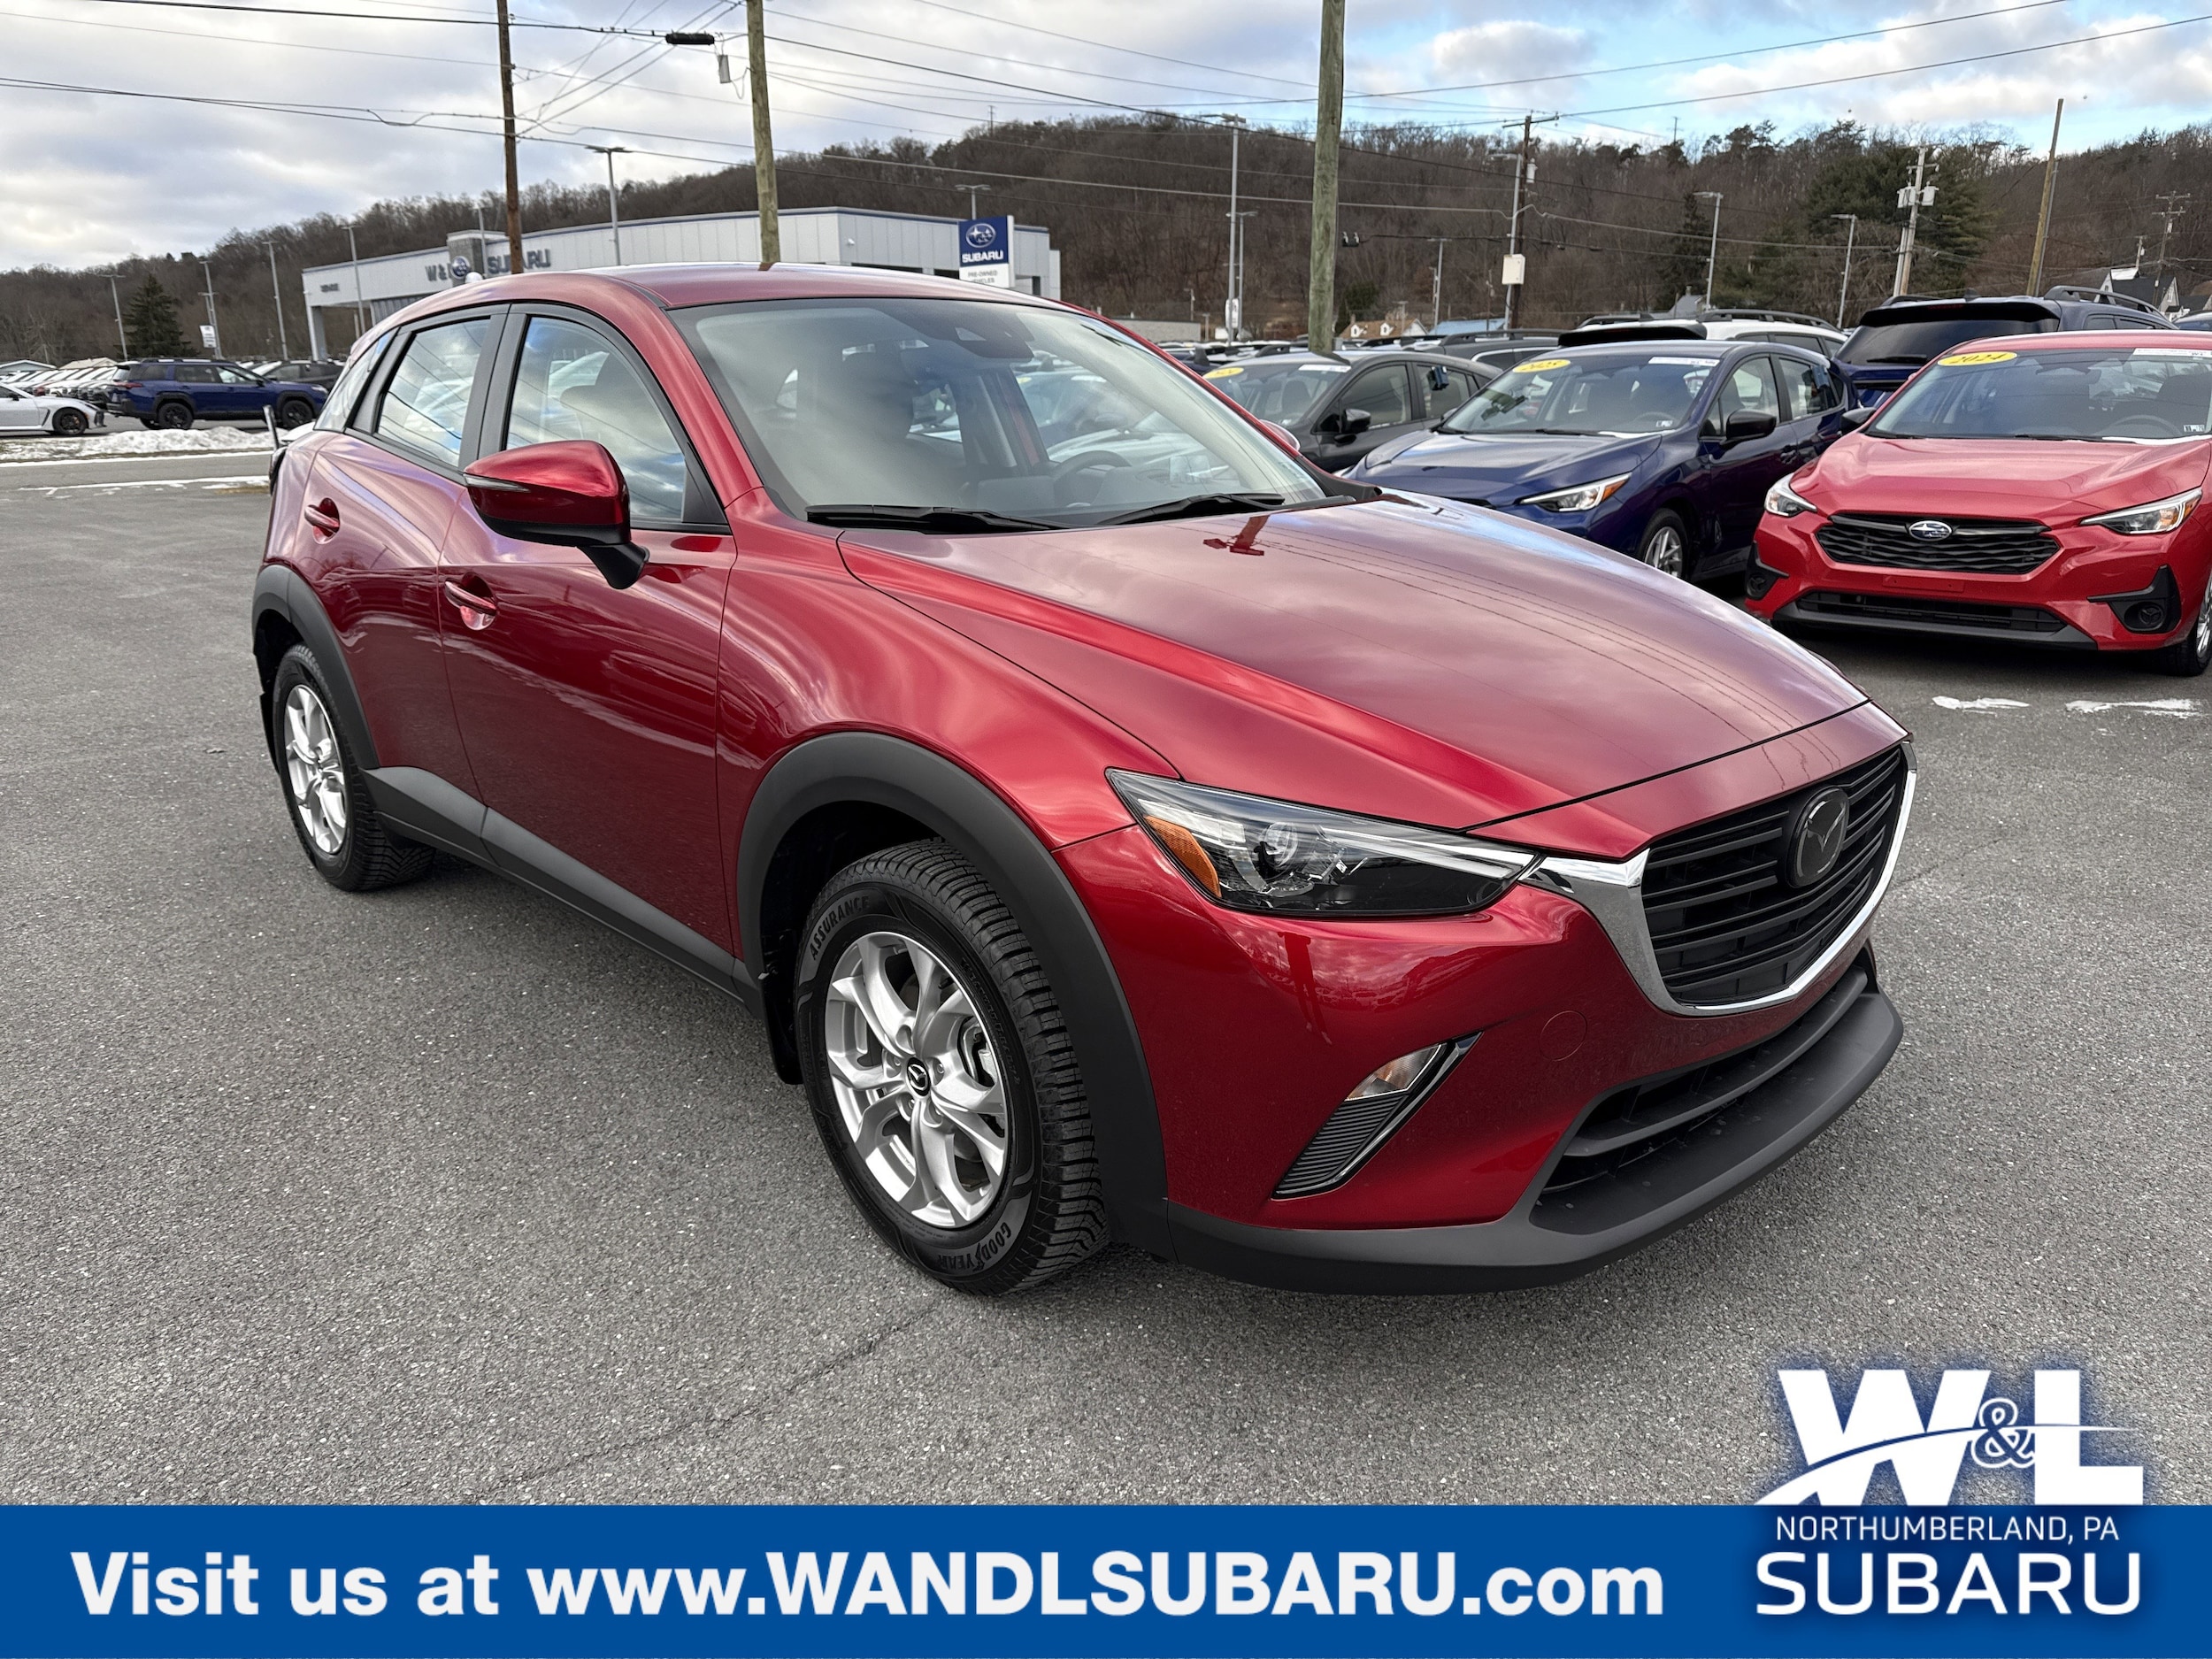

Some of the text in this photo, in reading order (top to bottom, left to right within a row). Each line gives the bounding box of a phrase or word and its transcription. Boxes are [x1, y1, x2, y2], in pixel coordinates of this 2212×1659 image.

[962, 250, 1003, 263] SUBARU
[1948, 353, 2008, 365] 2024
[810, 895, 870, 961] ASSURANCE
[938, 1222, 1011, 1271] GOODYEAR
